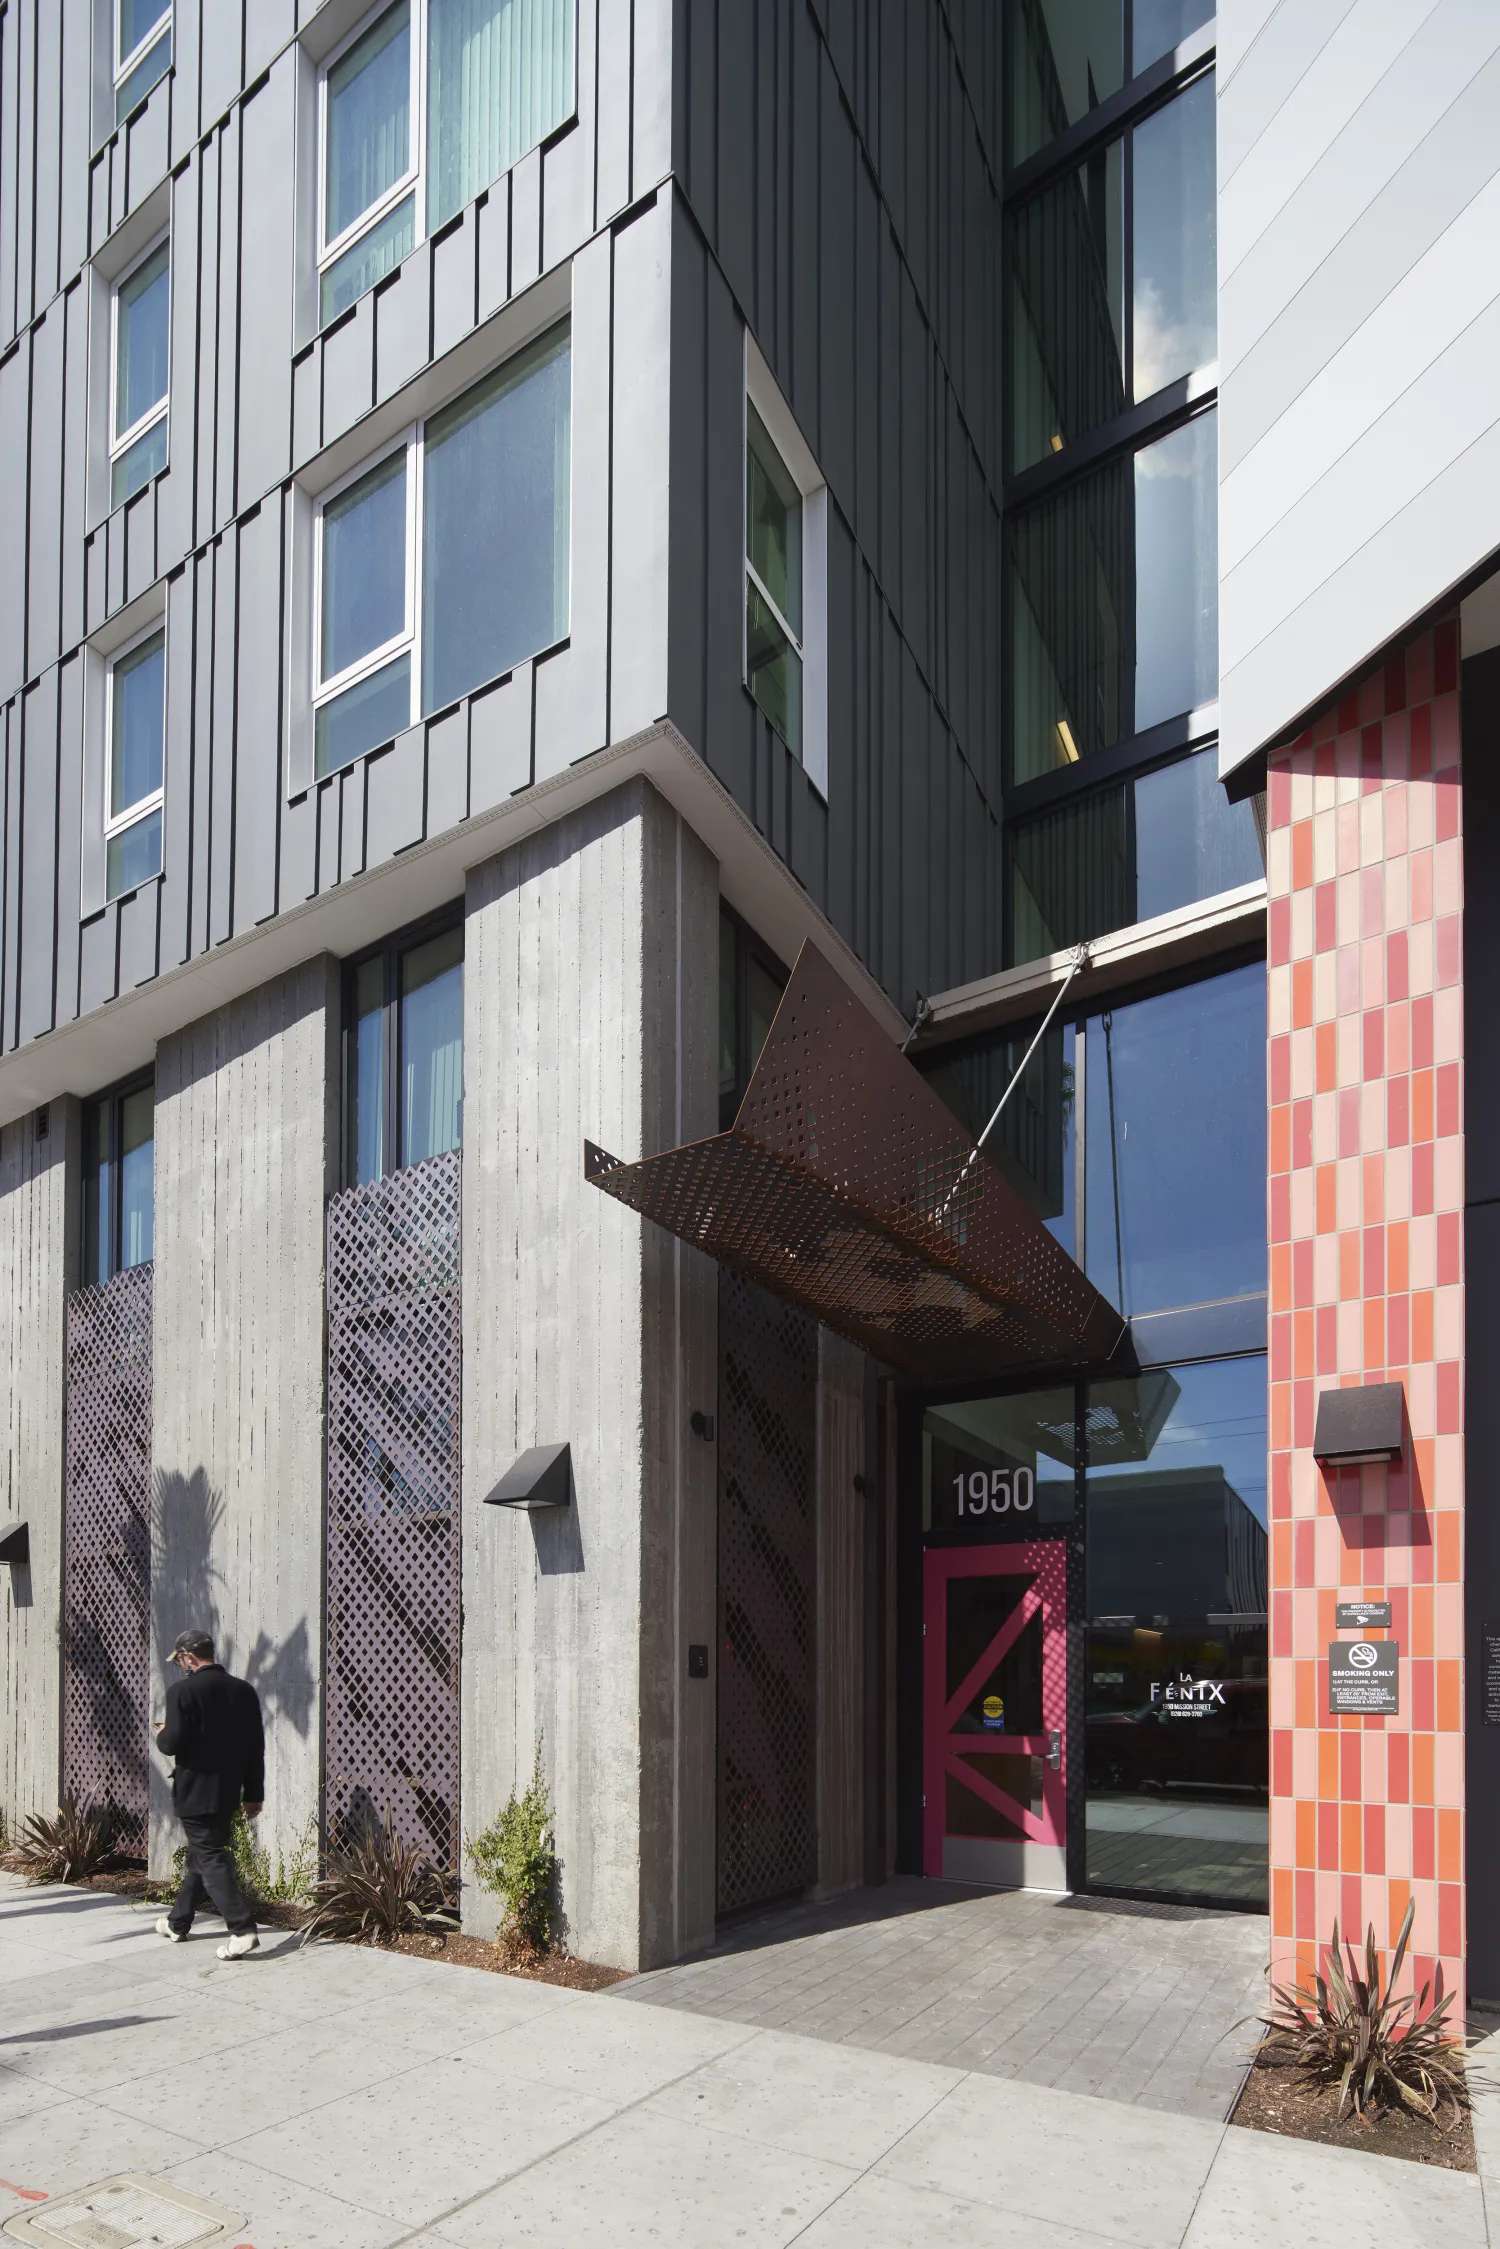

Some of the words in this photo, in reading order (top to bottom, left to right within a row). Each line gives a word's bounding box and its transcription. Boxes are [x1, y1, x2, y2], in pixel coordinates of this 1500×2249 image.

[952, 1466, 1034, 1516] 1950
[1180, 1672, 1193, 1682] LA
[1193, 1703, 1212, 1711] STREET
